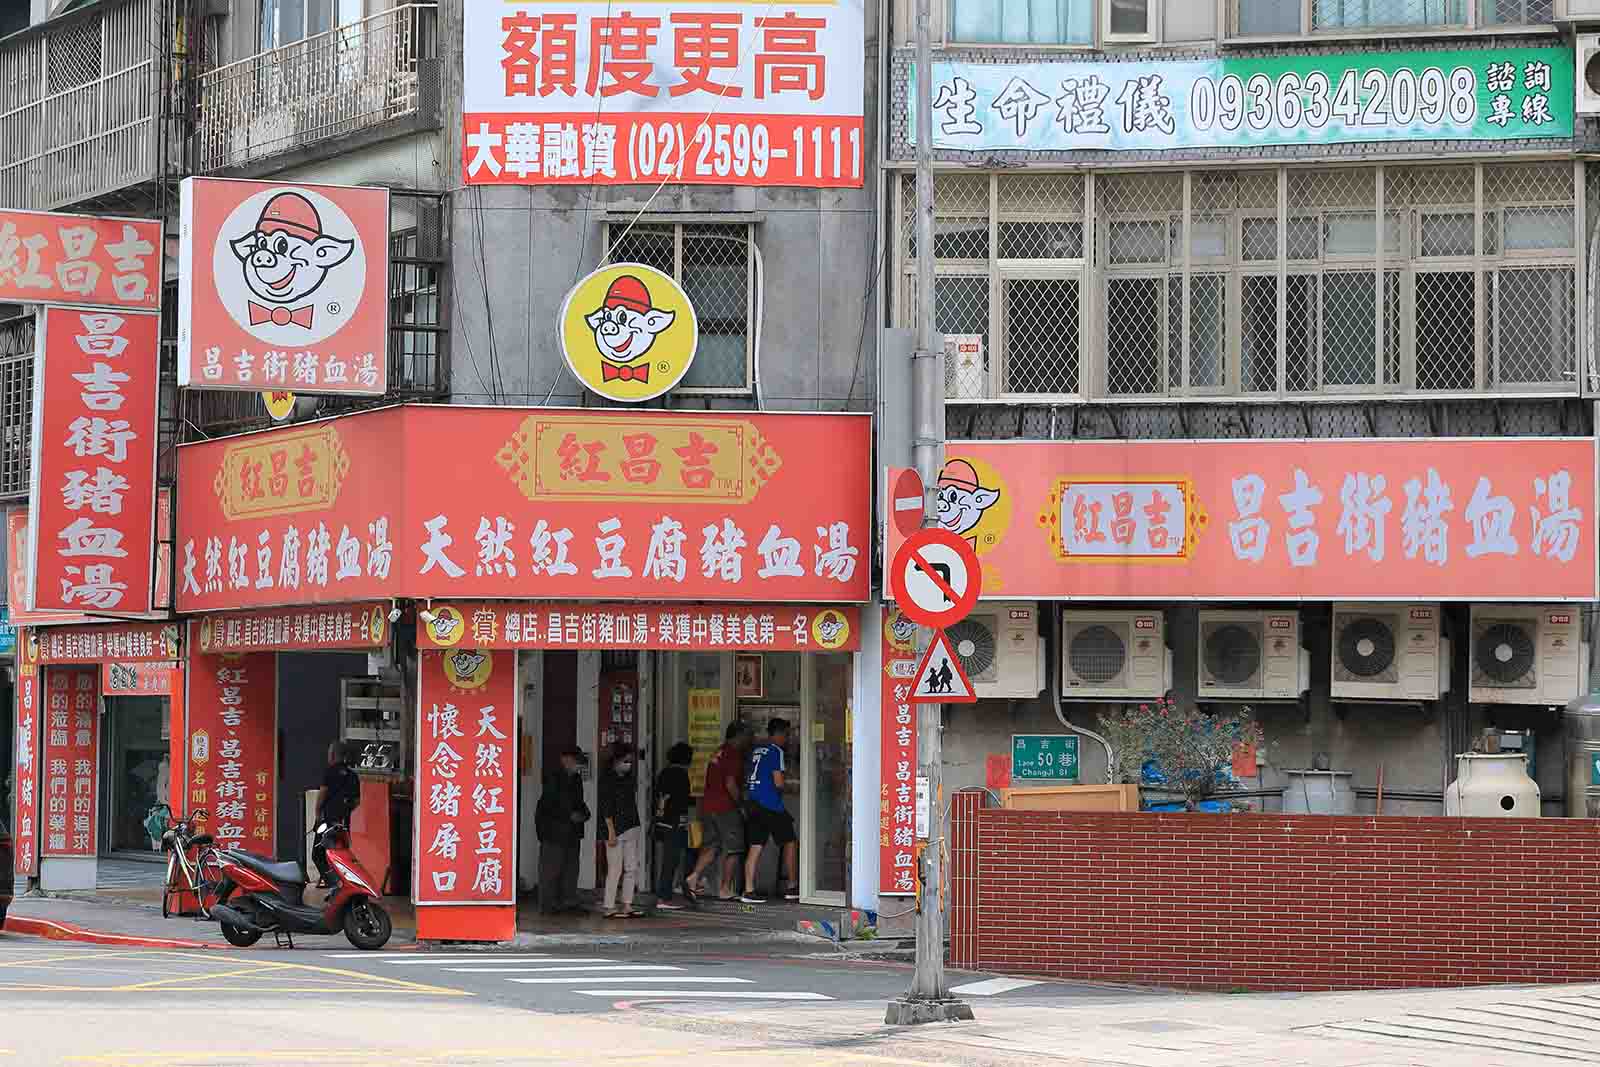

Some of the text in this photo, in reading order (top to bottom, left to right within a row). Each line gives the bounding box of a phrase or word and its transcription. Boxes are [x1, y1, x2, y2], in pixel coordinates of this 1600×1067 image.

[501, 11, 827, 100] 額度更高
[1486, 61, 1552, 92] 諮詢
[933, 67, 1477, 136] 生命禮儀 0936342098
[1486, 94, 1553, 128] 專線
[467, 121, 617, 178] 大華融資
[0, 223, 154, 301] 紅昌吉
[201, 346, 380, 385] 昌吉街豬血湯
[57, 314, 137, 608] 昌吉街豬血湯
[240, 441, 319, 501] 紅昌吉
[557, 431, 719, 488] 紅昌吉
[418, 513, 860, 584] 天然紅豆腐豬血湯
[1072, 488, 1170, 549] 紅昌吉
[1227, 467, 1583, 567] 昌吉街豬血湯
[182, 513, 393, 597] 天然紅豆腐豬血湯
[426, 702, 464, 891] 懷念豬屠口
[472, 705, 507, 895] 天然紅豆腐
